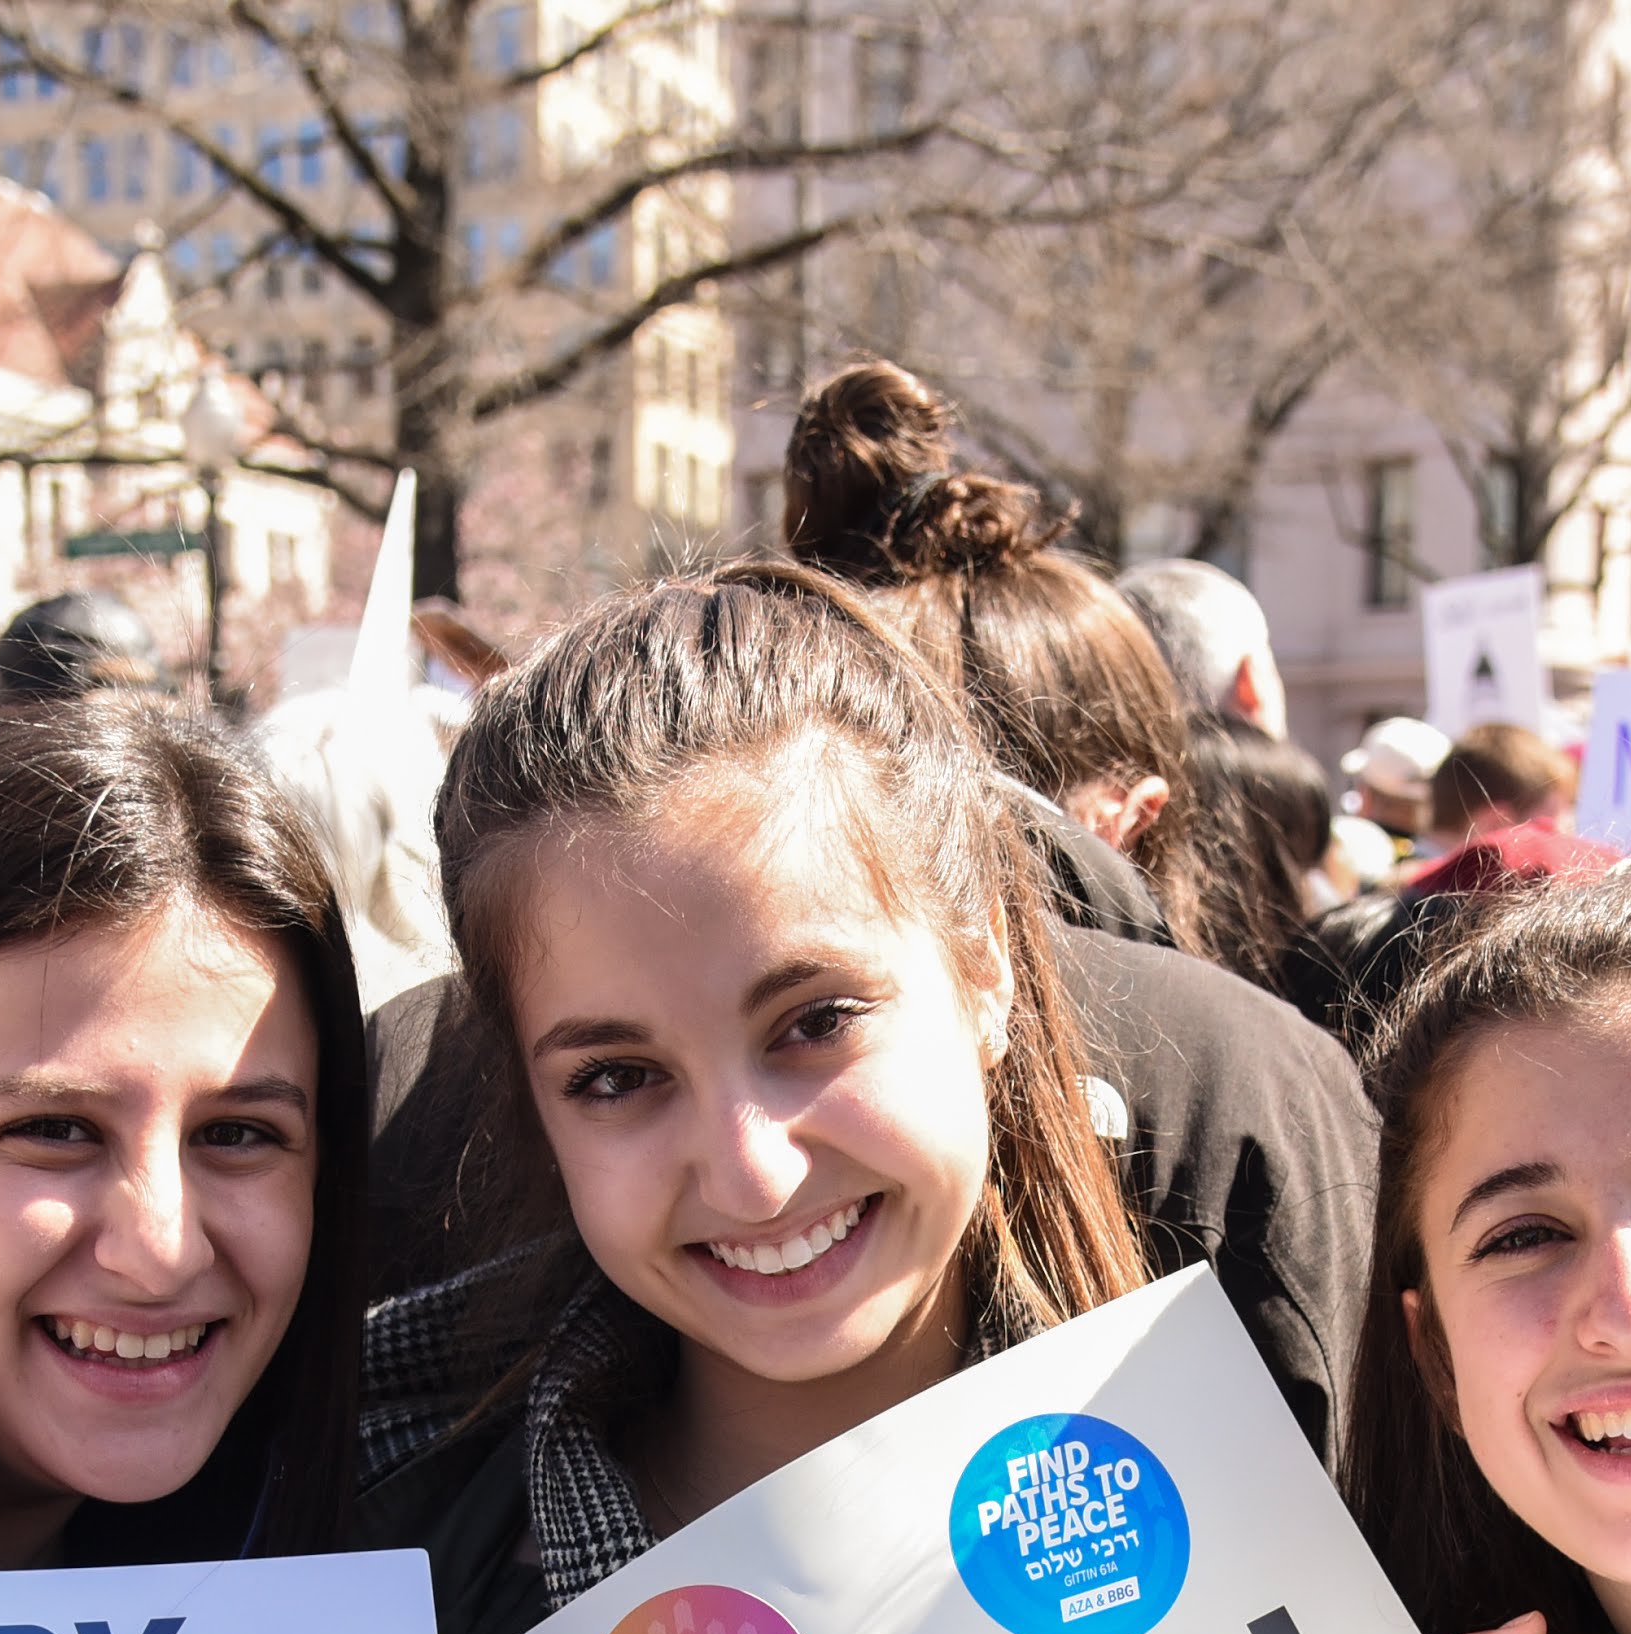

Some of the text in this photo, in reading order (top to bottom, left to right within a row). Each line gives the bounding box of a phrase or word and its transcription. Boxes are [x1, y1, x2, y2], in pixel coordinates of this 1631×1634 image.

[1007, 1441, 1090, 1493] FIND
[977, 1458, 1140, 1537] PATHS TO
[1017, 1493, 1127, 1557] PEACE
[1025, 1529, 1140, 1581] דרכי שלום
[1064, 1560, 1118, 1587] GITTIN 61A
[1068, 1584, 1134, 1616] AZA & BBG
